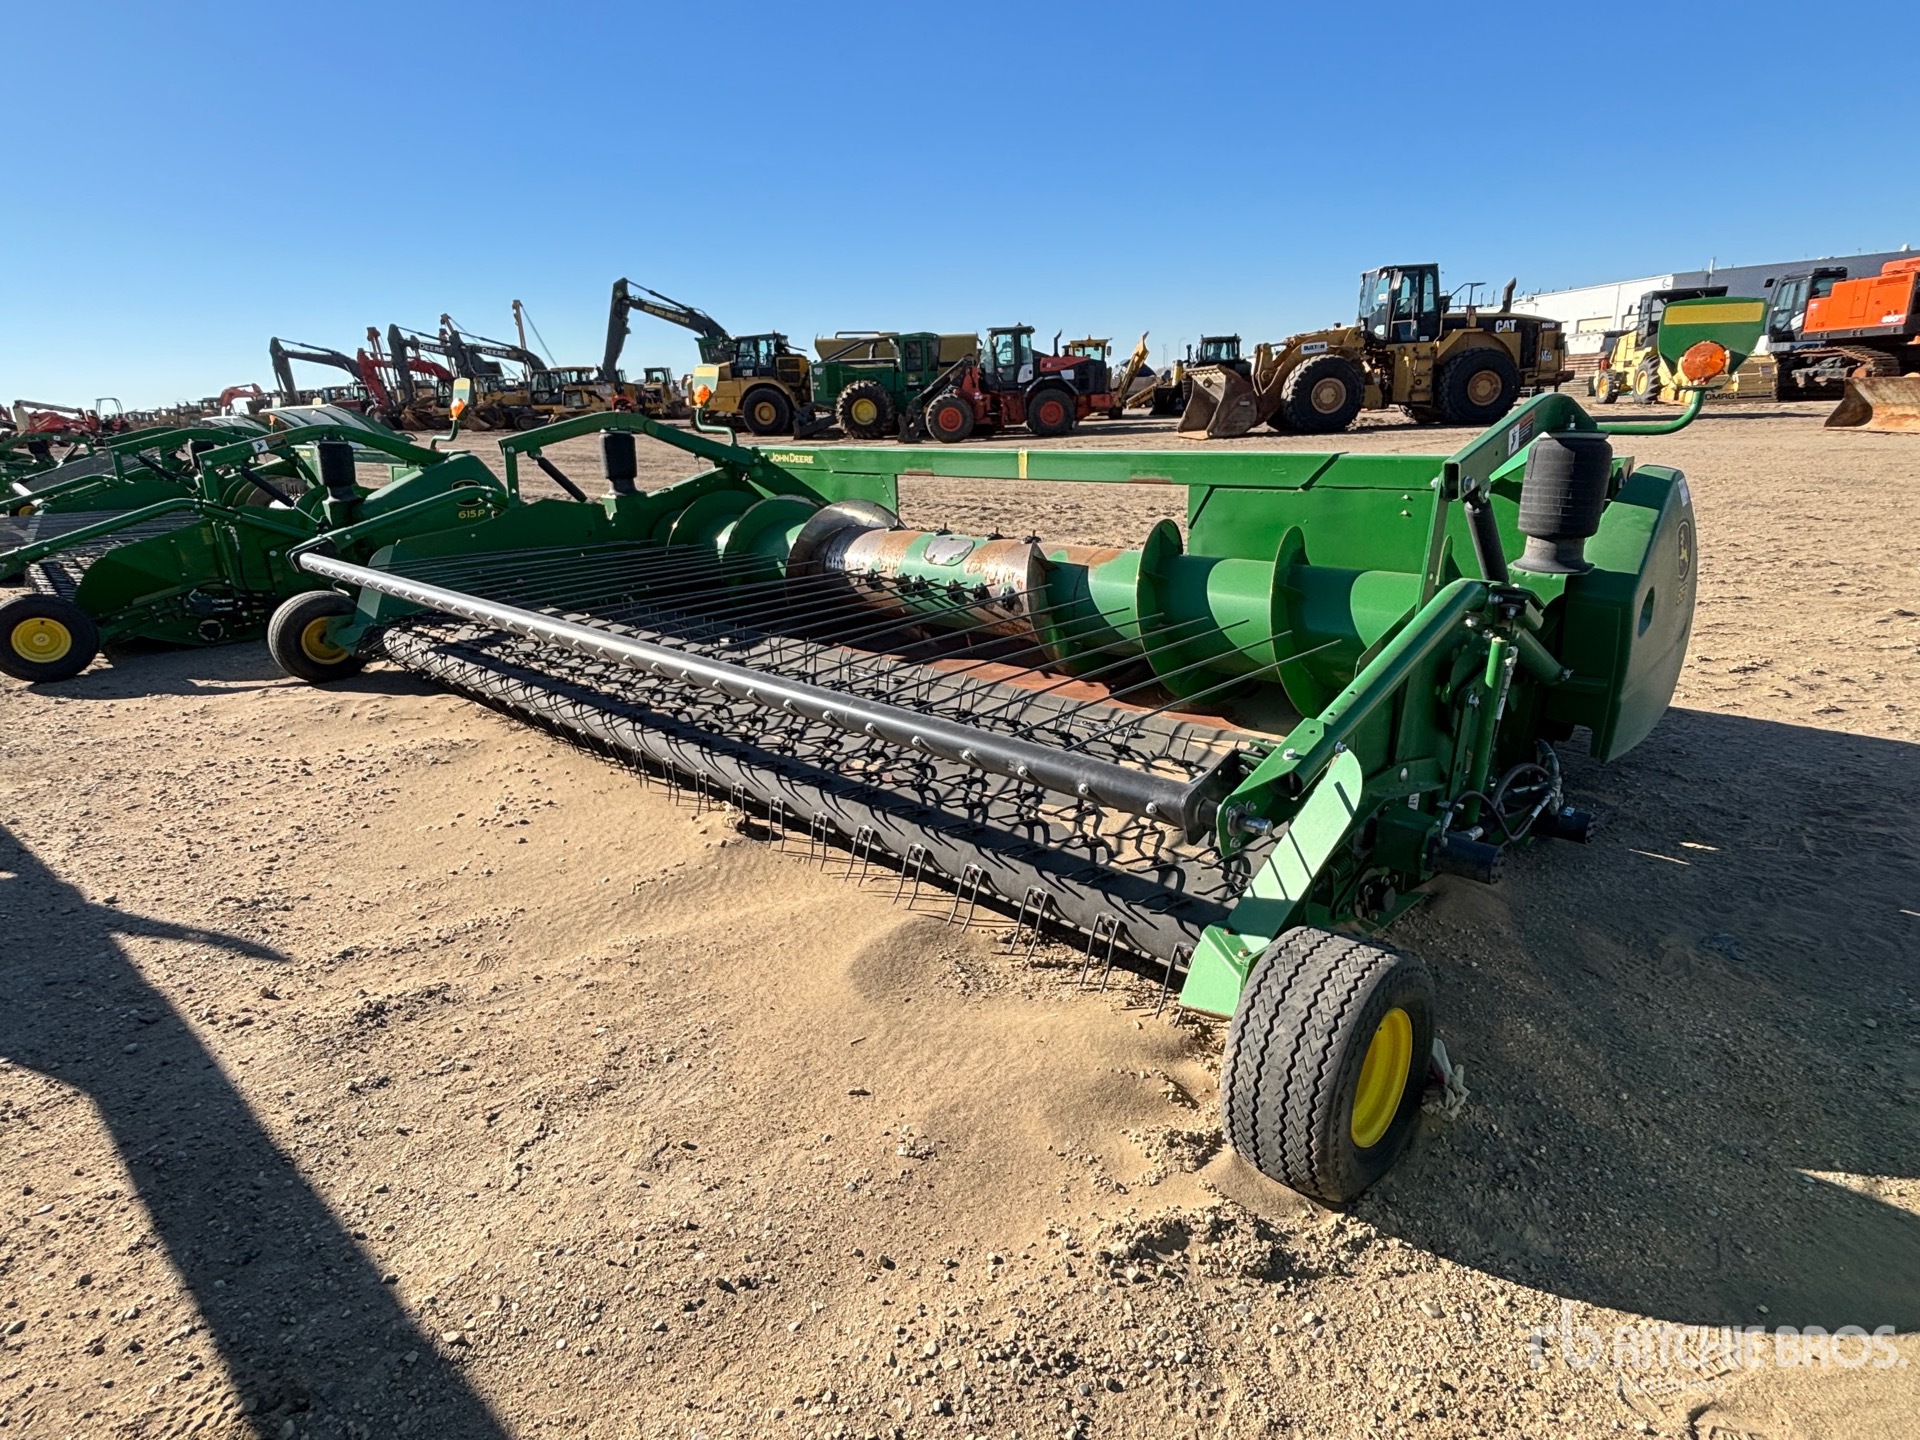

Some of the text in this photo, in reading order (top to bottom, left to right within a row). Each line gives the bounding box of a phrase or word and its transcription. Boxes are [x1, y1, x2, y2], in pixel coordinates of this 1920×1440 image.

[1495, 319, 1517, 333] CAT
[419, 342, 445, 354] DEERE
[481, 347, 508, 358] DEERE
[1704, 392, 1735, 401] OMAG
[770, 452, 814, 464] JOHN DEERE
[458, 508, 486, 519] 615P
